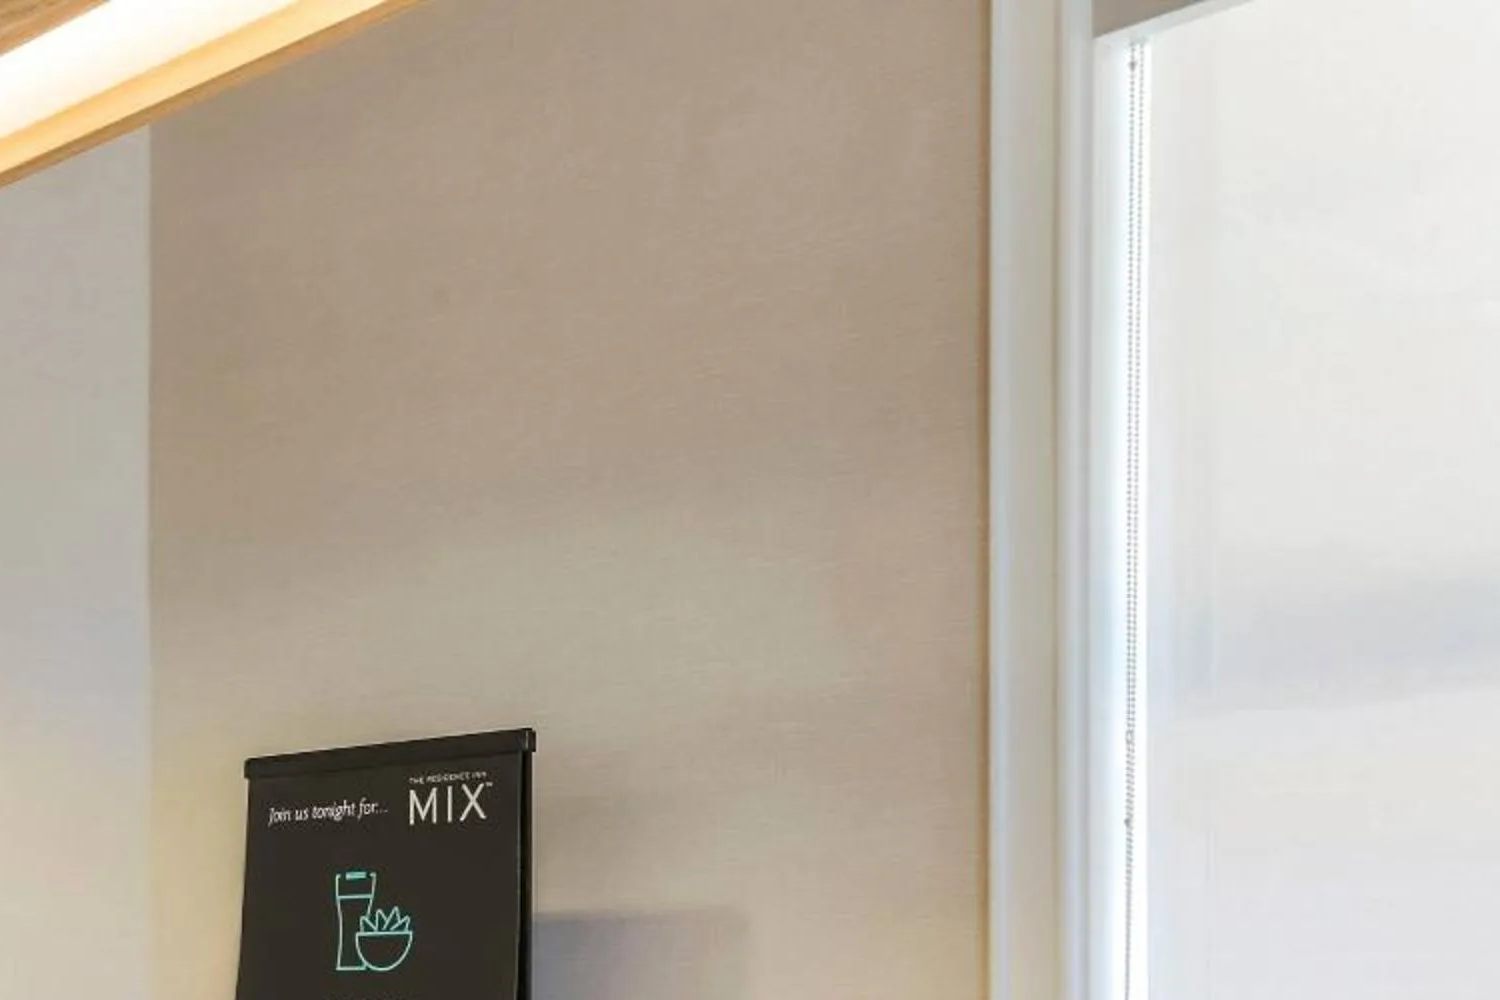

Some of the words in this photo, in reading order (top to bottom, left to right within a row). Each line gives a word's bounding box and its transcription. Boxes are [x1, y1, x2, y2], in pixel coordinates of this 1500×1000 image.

[267, 806, 292, 827] Join
[295, 807, 309, 821] us
[311, 799, 356, 822] tonight
